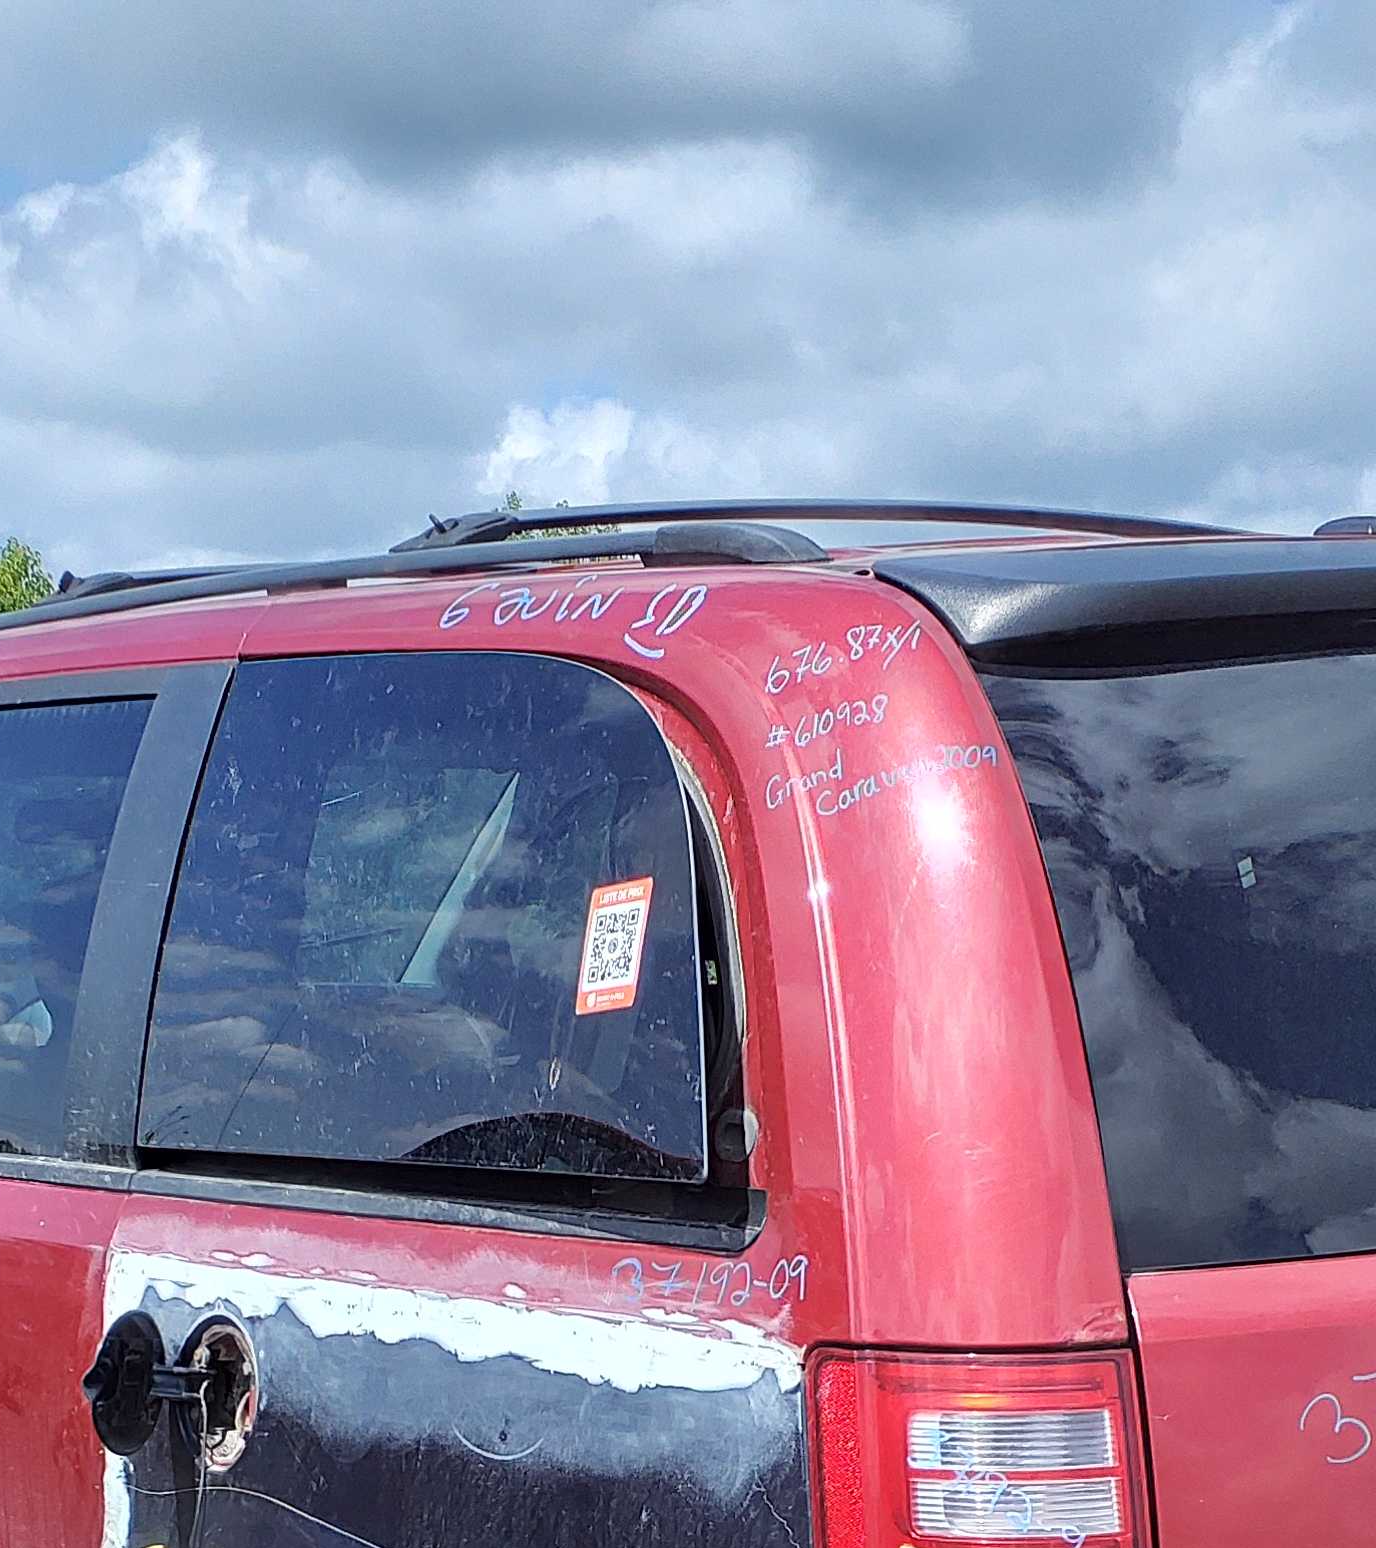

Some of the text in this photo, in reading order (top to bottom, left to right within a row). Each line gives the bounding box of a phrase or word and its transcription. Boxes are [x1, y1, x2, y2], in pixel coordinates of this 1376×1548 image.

[765, 694, 889, 749] #610928
[766, 748, 844, 810] Grand
[611, 1254, 809, 1311] 37192-09
